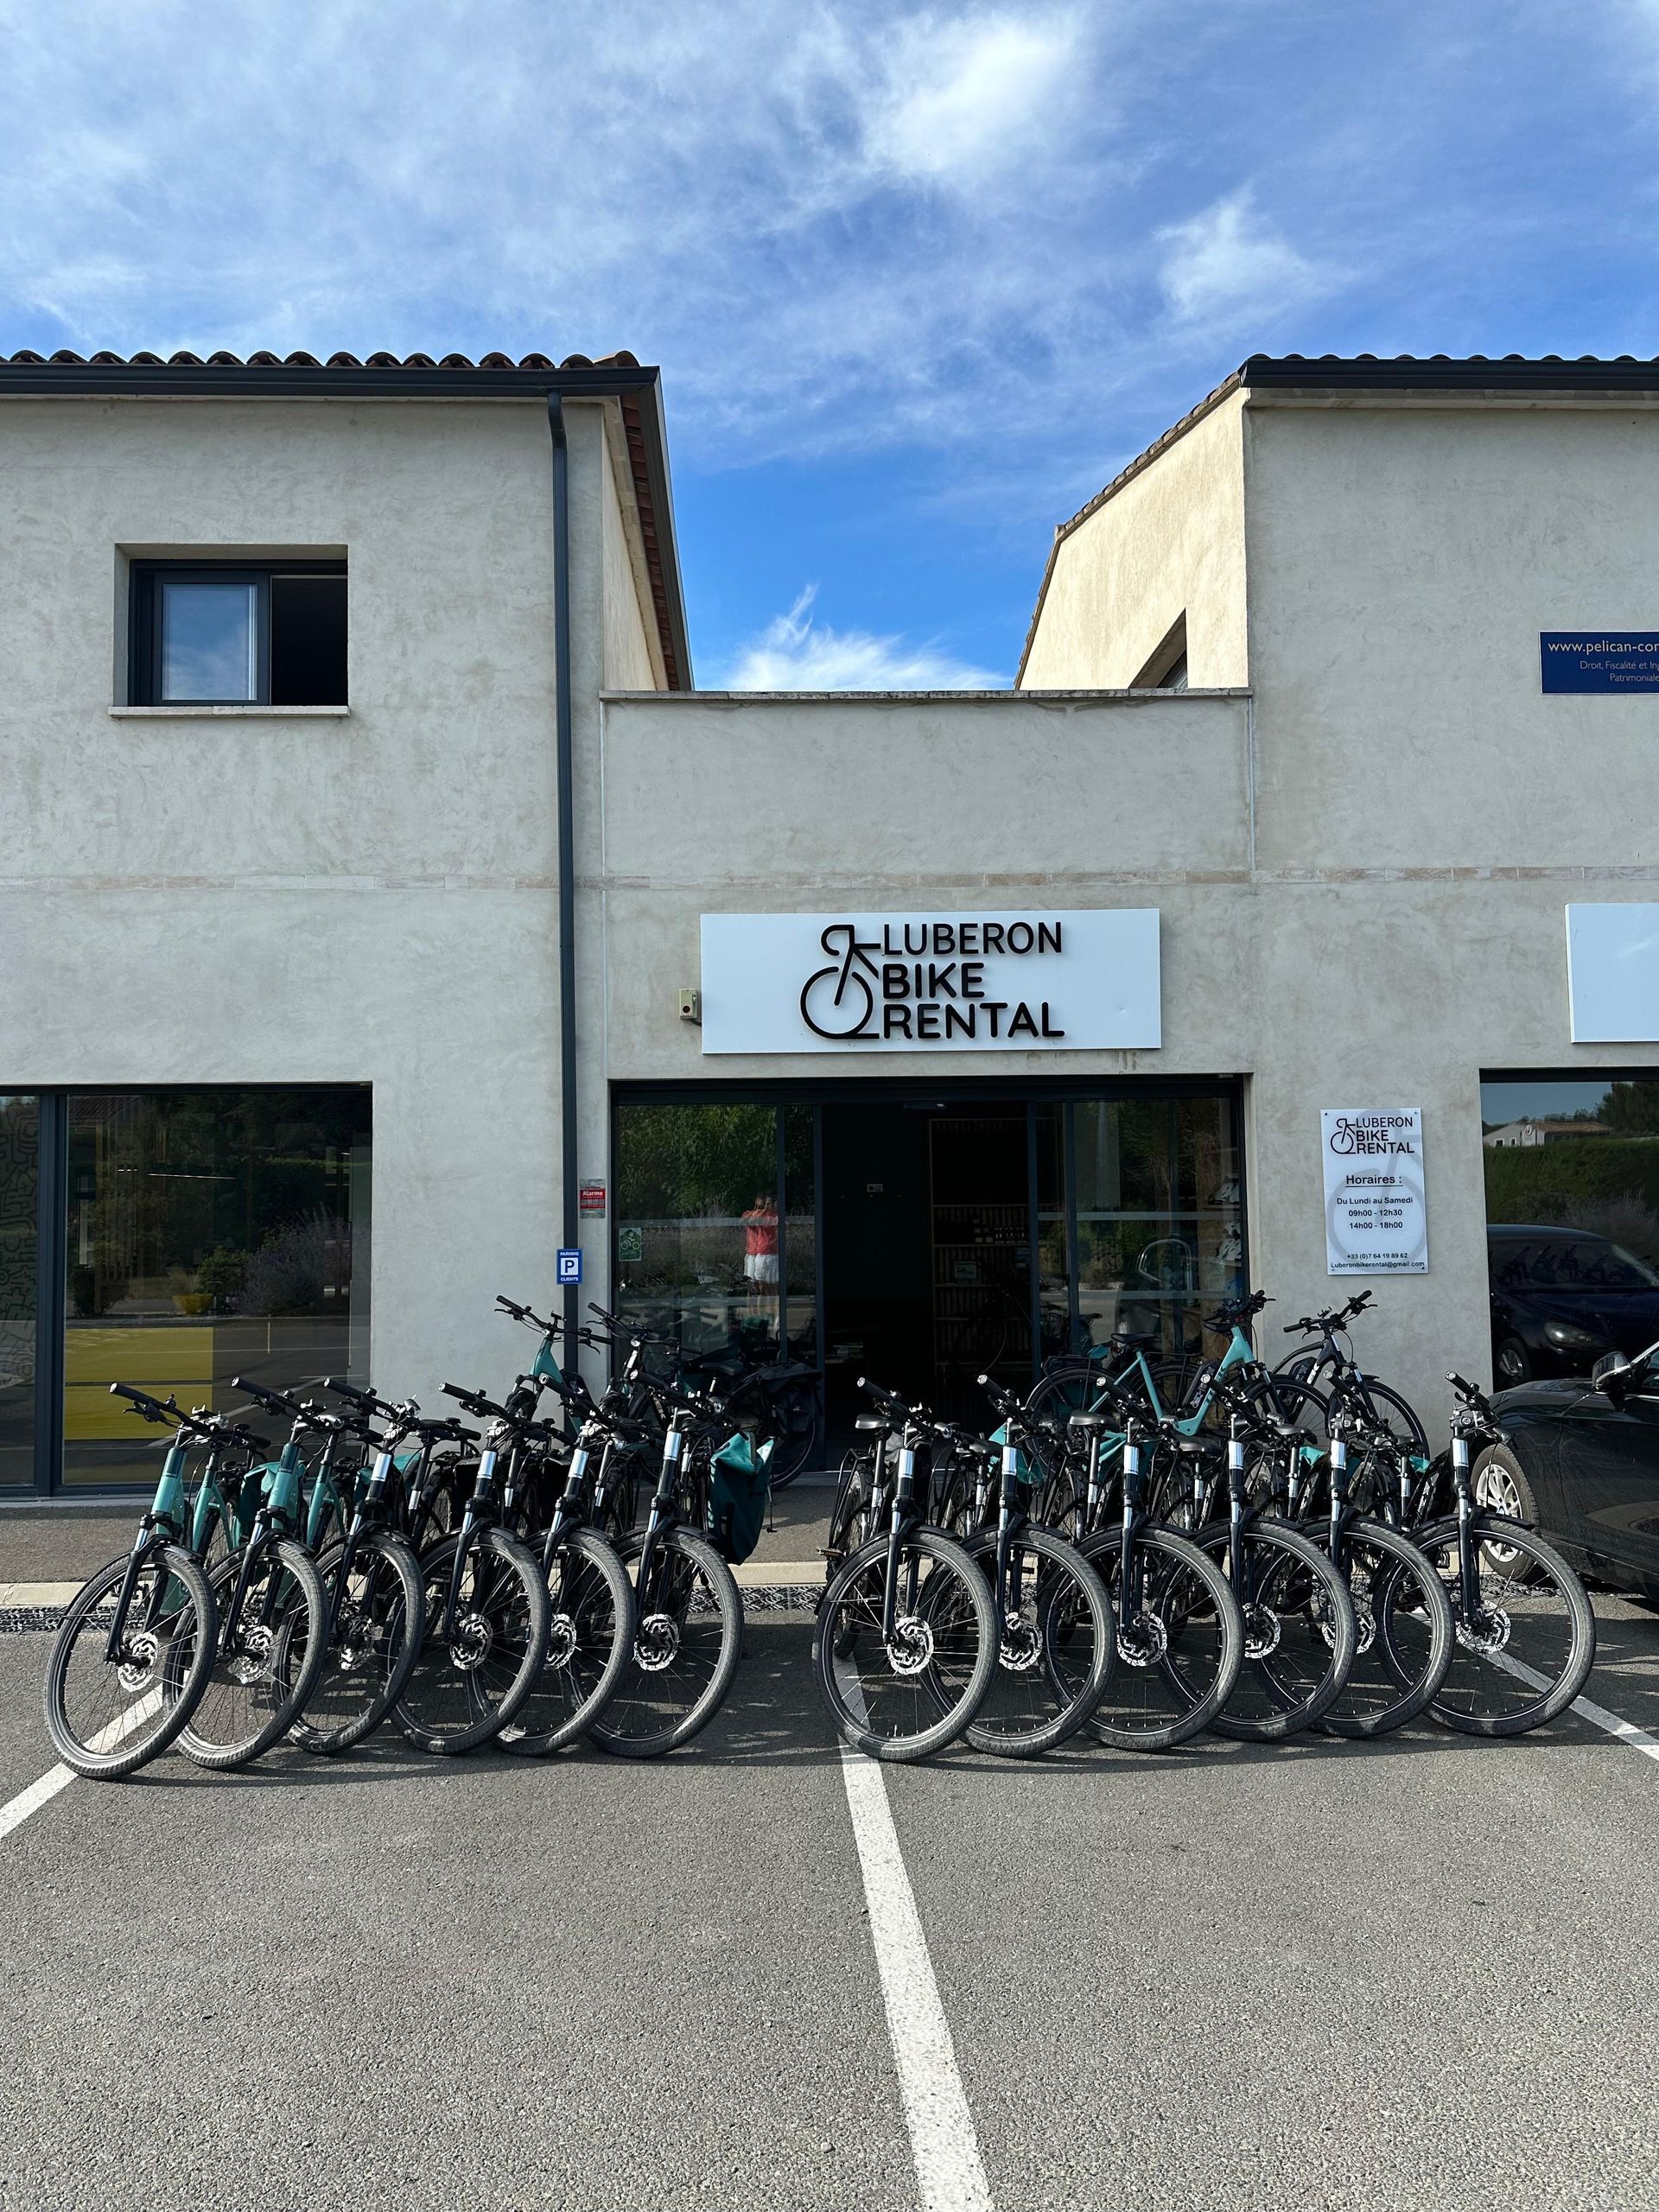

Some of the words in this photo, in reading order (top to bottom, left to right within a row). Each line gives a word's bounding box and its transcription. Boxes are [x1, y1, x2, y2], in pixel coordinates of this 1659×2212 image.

[1580, 660, 1604, 670] Droit,
[1605, 660, 1637, 670] Fiscalité
[1610, 673, 1659, 682] Patrimoniale
[883, 921, 1062, 956] LUBERON
[882, 962, 985, 1000] BIKE
[883, 1001, 1065, 1039] RENTAL
[1356, 1116, 1413, 1128] LUBERON
[1356, 1129, 1389, 1141] BIKE
[1357, 1141, 1414, 1154] RENTAL
[1345, 1174, 1395, 1185] Horaires
[564, 1260, 575, 1274] P
